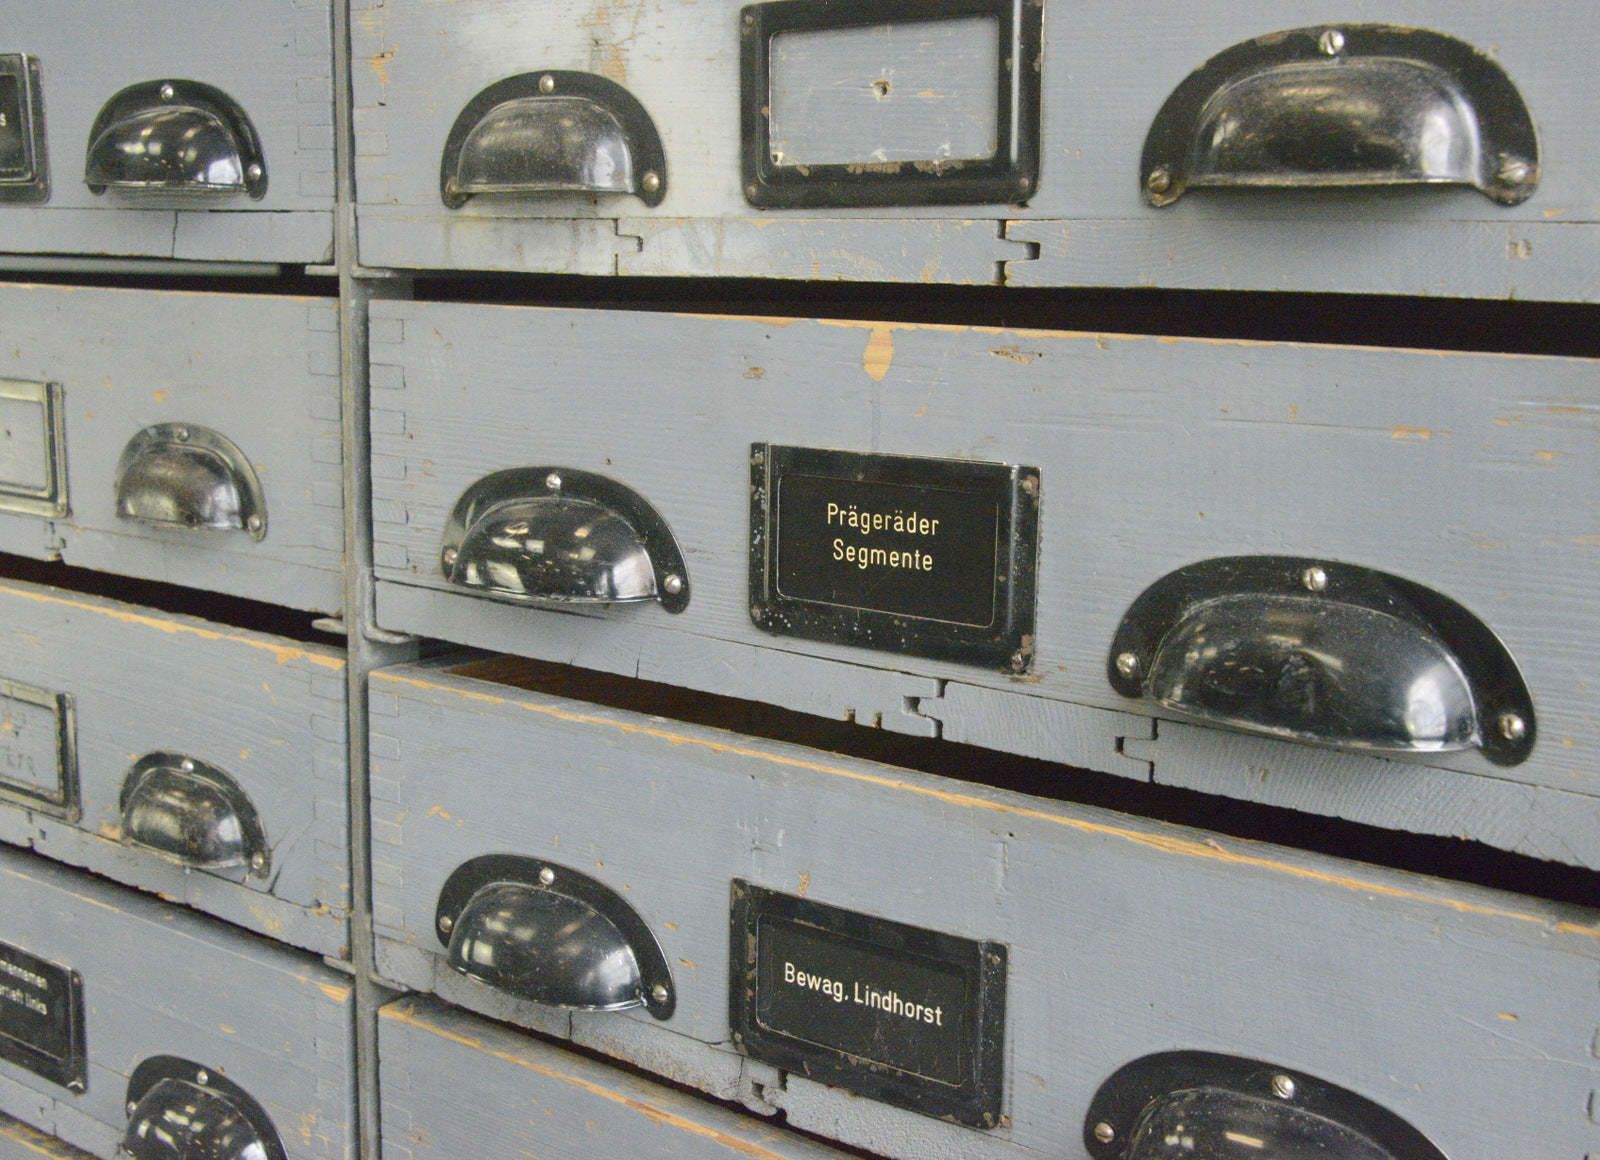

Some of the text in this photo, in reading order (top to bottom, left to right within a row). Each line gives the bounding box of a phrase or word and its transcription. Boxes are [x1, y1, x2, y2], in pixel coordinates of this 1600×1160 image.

[827, 502, 940, 535] Prägeräder
[832, 538, 933, 571] Segmente
[854, 981, 943, 1027] Lindhorst
